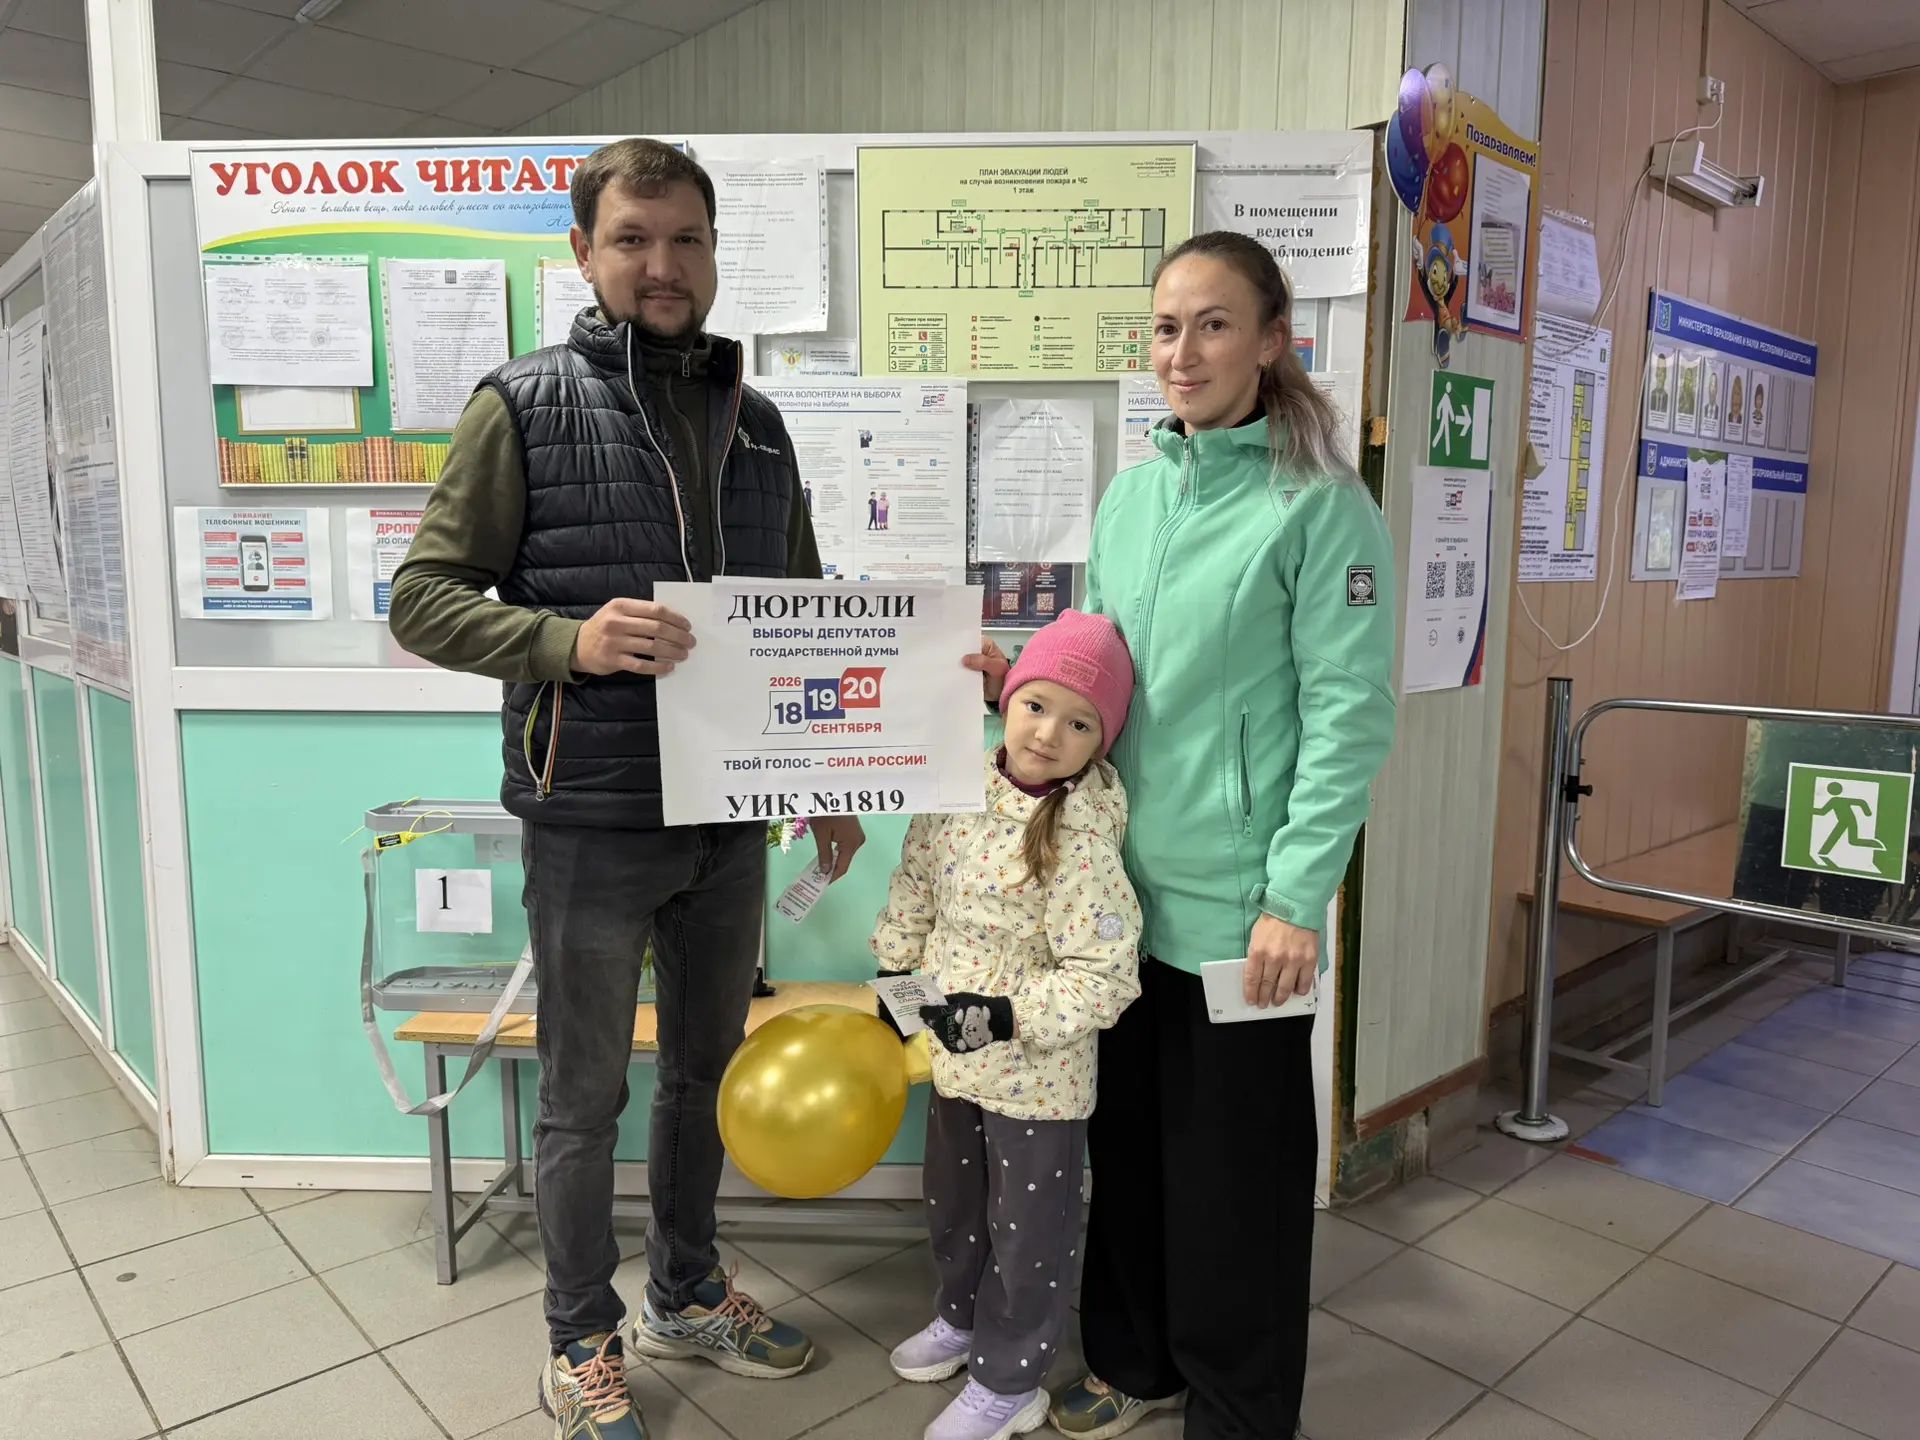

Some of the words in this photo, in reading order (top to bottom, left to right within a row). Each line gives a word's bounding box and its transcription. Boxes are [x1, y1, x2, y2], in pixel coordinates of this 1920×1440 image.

[1467, 123, 1537, 168] Поздравляем!
[209, 161, 405, 196] УГОЛОК
[416, 157, 582, 193] ЧИТАТ
[1000, 169, 1041, 177] ЭВАКУАЦИИ
[1043, 167, 1068, 176] ЛЮДЕЙ
[969, 177, 993, 186] случай
[271, 201, 306, 214] Книга
[508, 198, 571, 214] пользоватьс
[1234, 204, 1245, 217] В
[1250, 207, 1338, 219] помещении
[1256, 227, 1314, 238] ведется
[1271, 246, 1354, 258] аблюдение
[891, 346, 897, 355] 2
[1099, 345, 1105, 354] 2
[891, 361, 897, 370] 3
[1099, 360, 1105, 369] 3
[759, 391, 794, 399] АМЯТКА
[796, 390, 849, 399] ВОЛОНТЕРАМ
[851, 391, 862, 399] НА
[864, 391, 901, 399] ВЫБОРАХ
[1128, 398, 1165, 406] НАБЛЮД
[728, 595, 916, 624] ДЮРТЮЛИ
[752, 628, 814, 638] ВЫБОРЫ
[817, 628, 896, 640] ДЕПУТАТОВ
[749, 646, 863, 658] ГОСУДАРСТВЕННОЙ
[865, 647, 899, 657] ДУМЫ
[769, 676, 802, 687] 2026
[774, 702, 803, 725] 18
[808, 688, 837, 711] 19
[842, 676, 877, 699] 20
[811, 722, 882, 734] СЕНТЯБРЯ
[723, 757, 762, 770] ТВОЙ
[765, 757, 811, 770] ГОЛОС
[827, 757, 865, 768] СИЛА
[868, 755, 927, 767] РОССИИ!
[726, 792, 800, 819] УИК
[808, 789, 905, 813] №1819
[438, 875, 452, 910] 1
